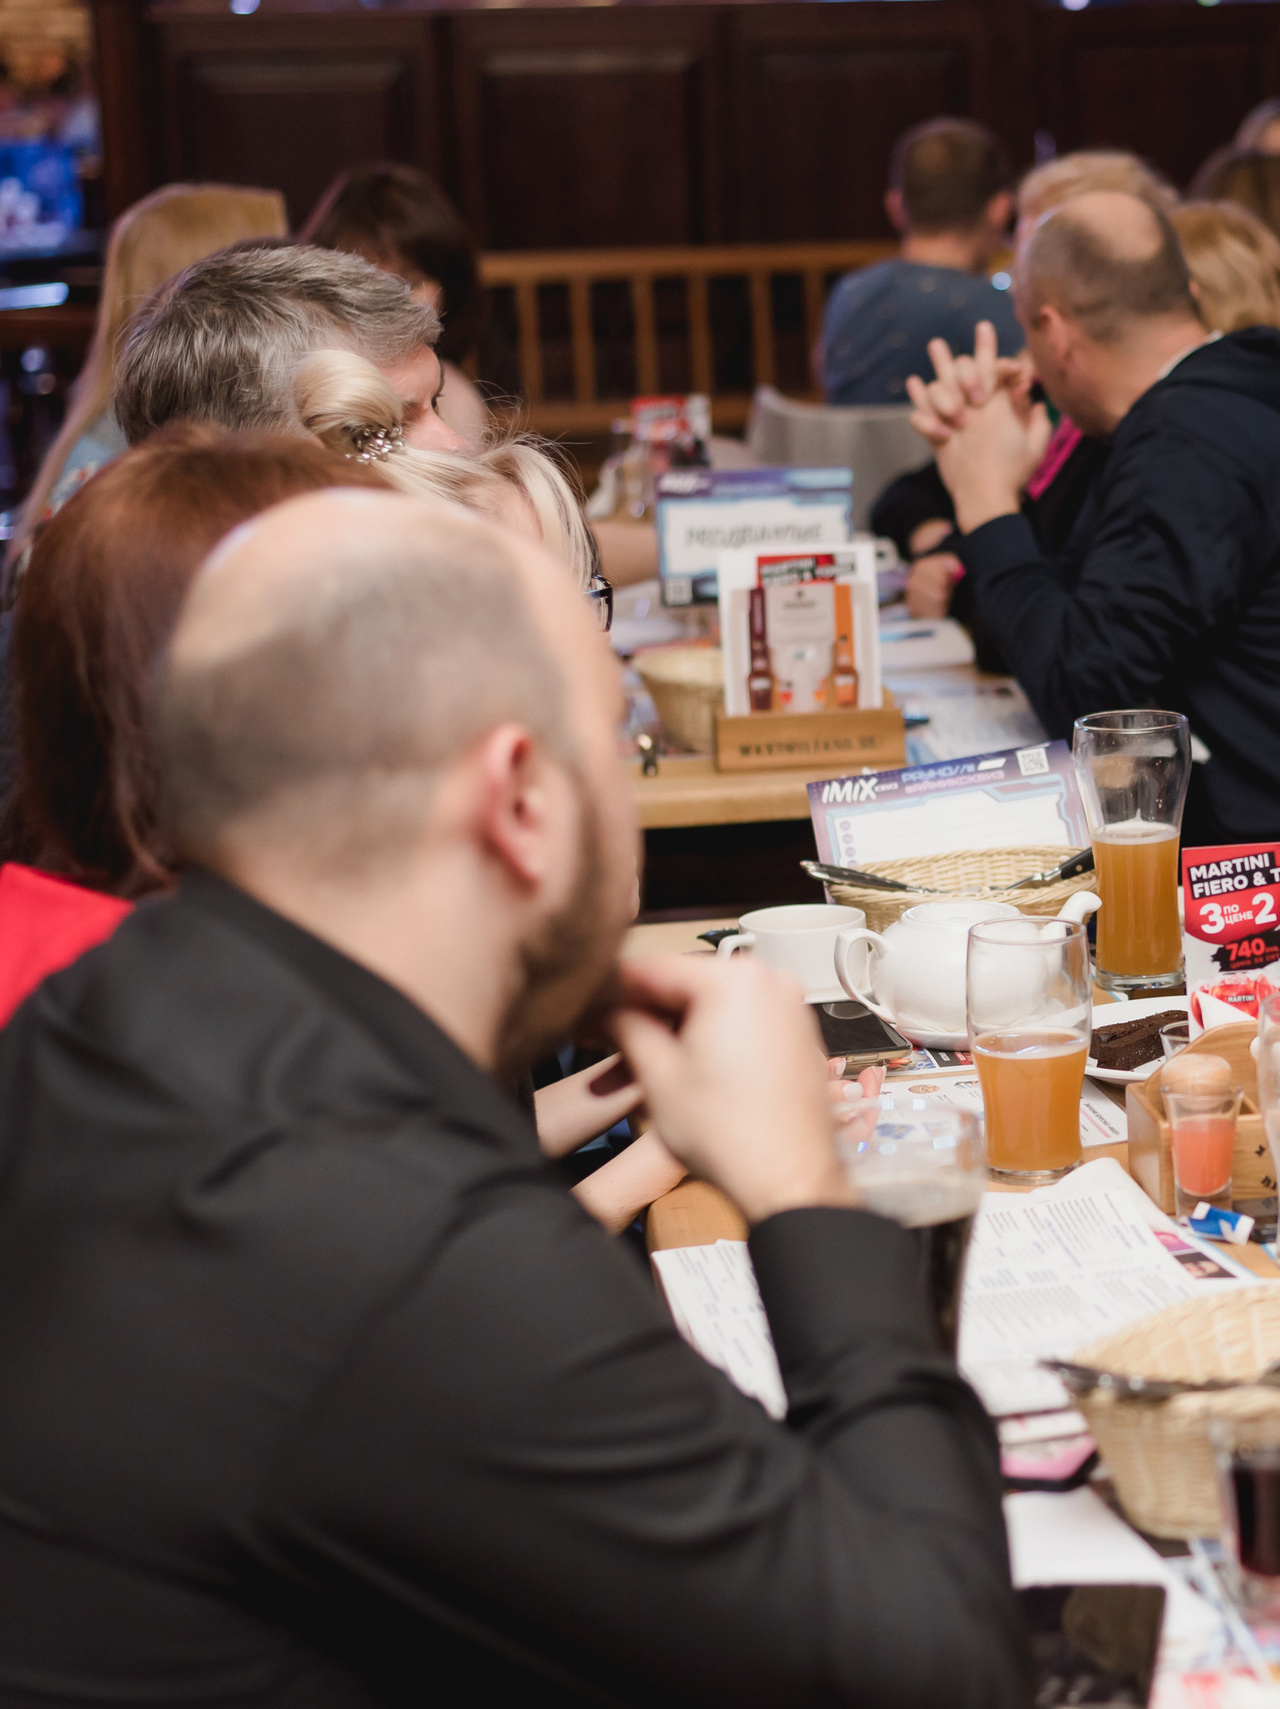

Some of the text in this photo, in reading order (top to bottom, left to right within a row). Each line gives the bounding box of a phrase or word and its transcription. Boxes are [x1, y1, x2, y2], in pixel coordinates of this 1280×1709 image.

[821, 777, 879, 804] IMIX
[1189, 853, 1270, 882] MARTINI
[1192, 874, 1249, 899] FIERO
[1252, 871, 1267, 887] &
[1199, 892, 1278, 934] 3 ПО ЦЕНЕ 2
[1225, 937, 1266, 961] 740
[1227, 994, 1255, 1003] MARTINI
